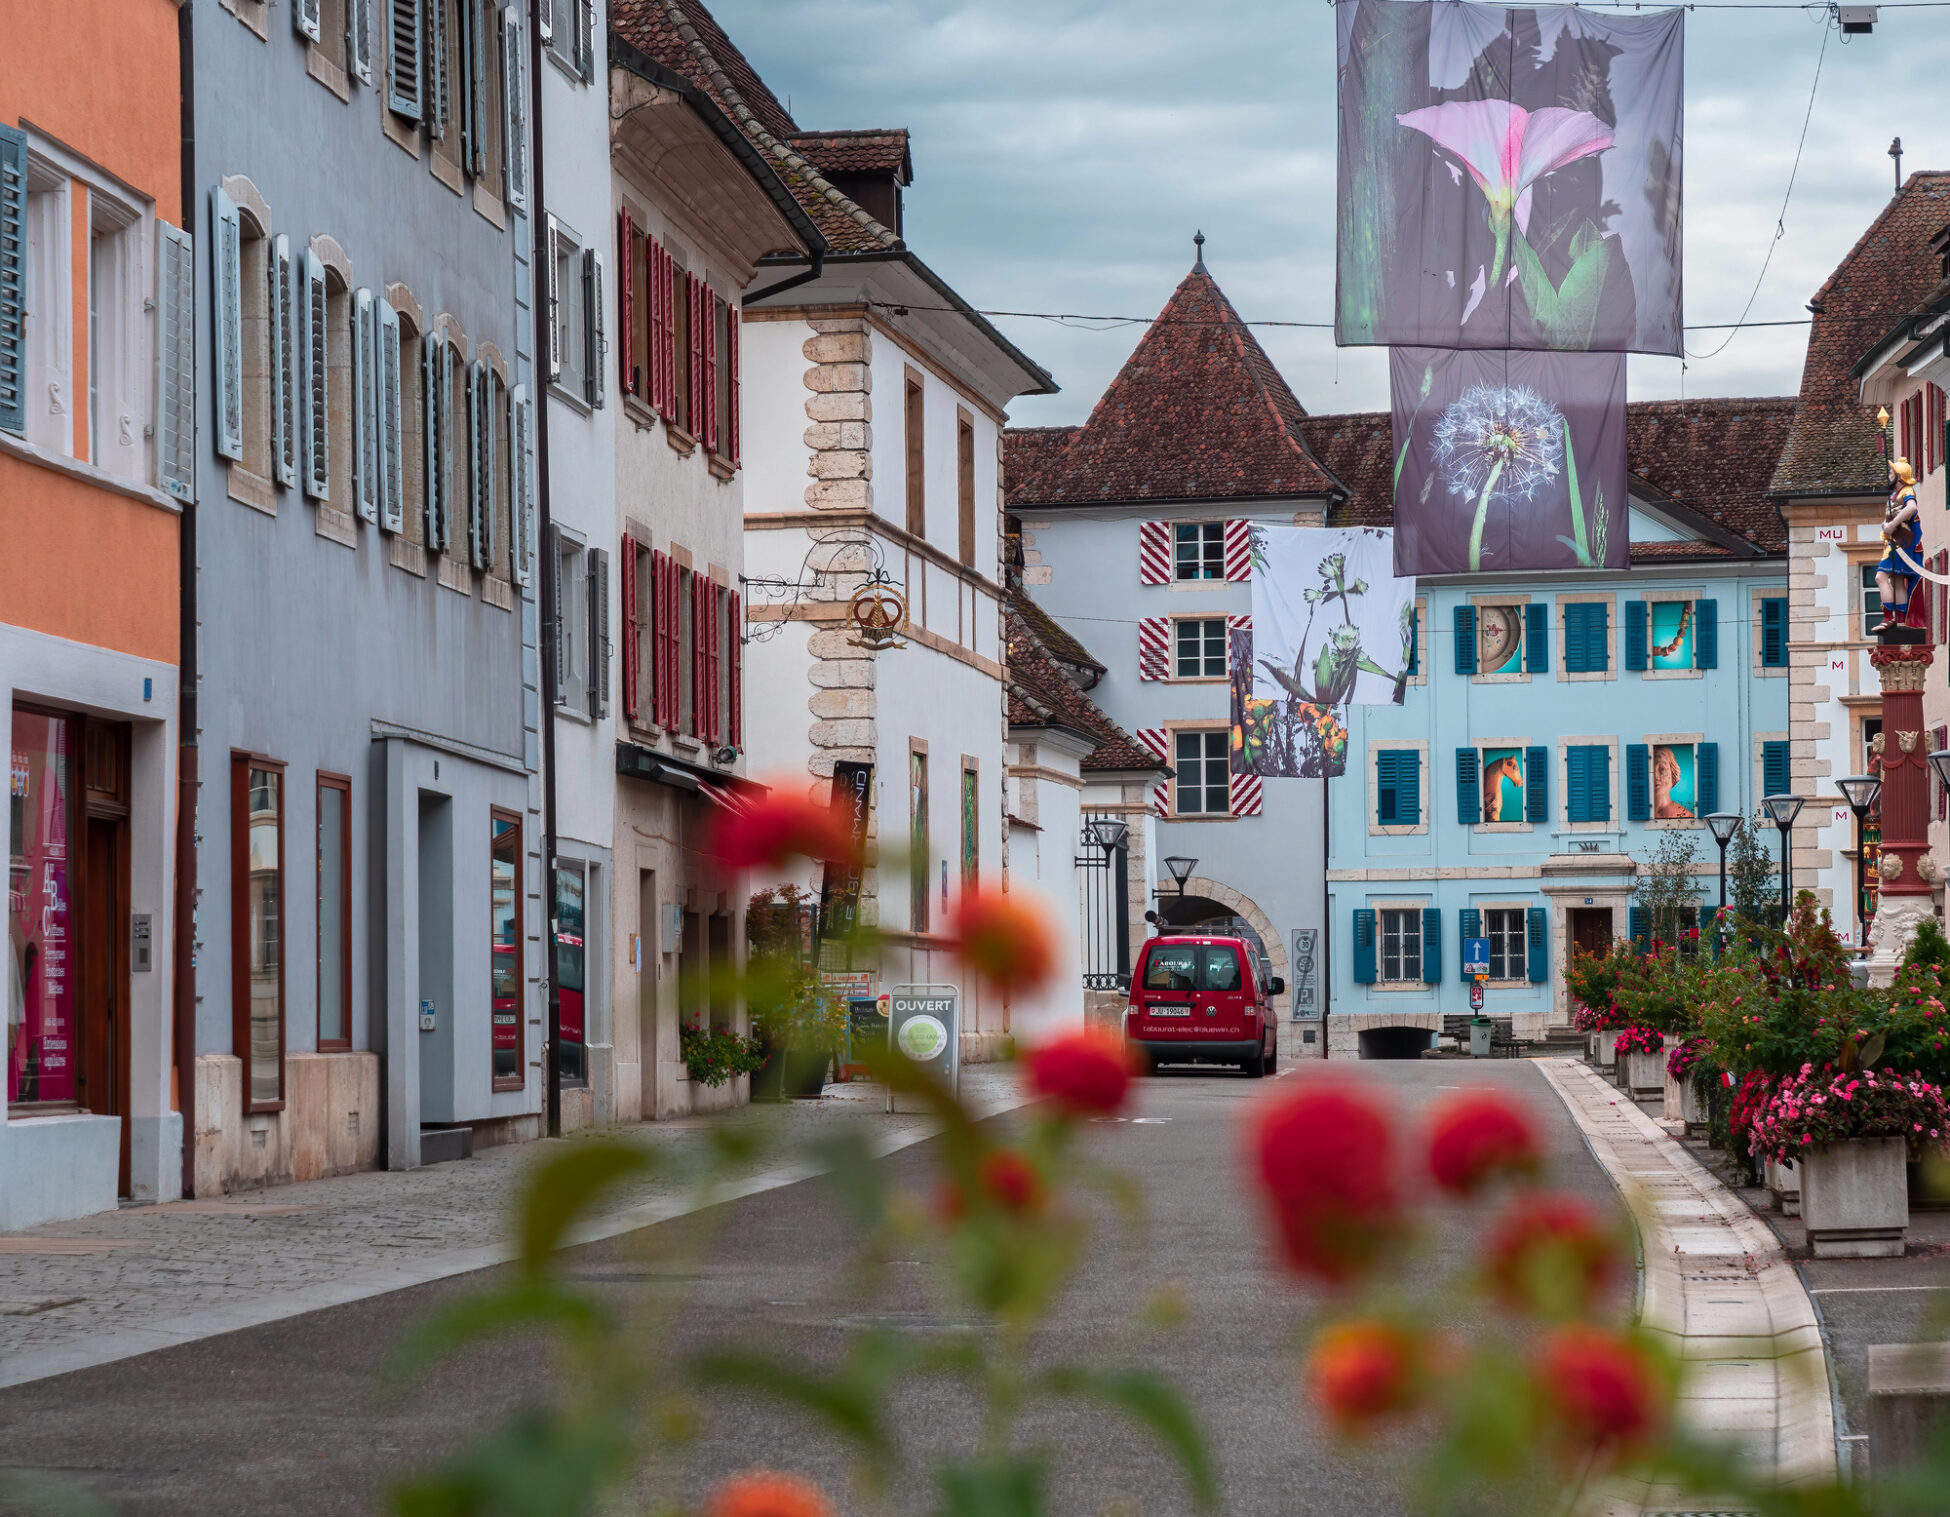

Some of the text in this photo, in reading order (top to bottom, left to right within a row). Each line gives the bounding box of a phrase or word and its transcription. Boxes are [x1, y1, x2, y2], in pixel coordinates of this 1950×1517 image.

[1819, 529, 1843, 539] MU
[1831, 660, 1844, 670] M
[1835, 811, 1847, 820] M
[1302, 941, 1310, 949] 30
[896, 1000, 952, 1011] OUVERT
